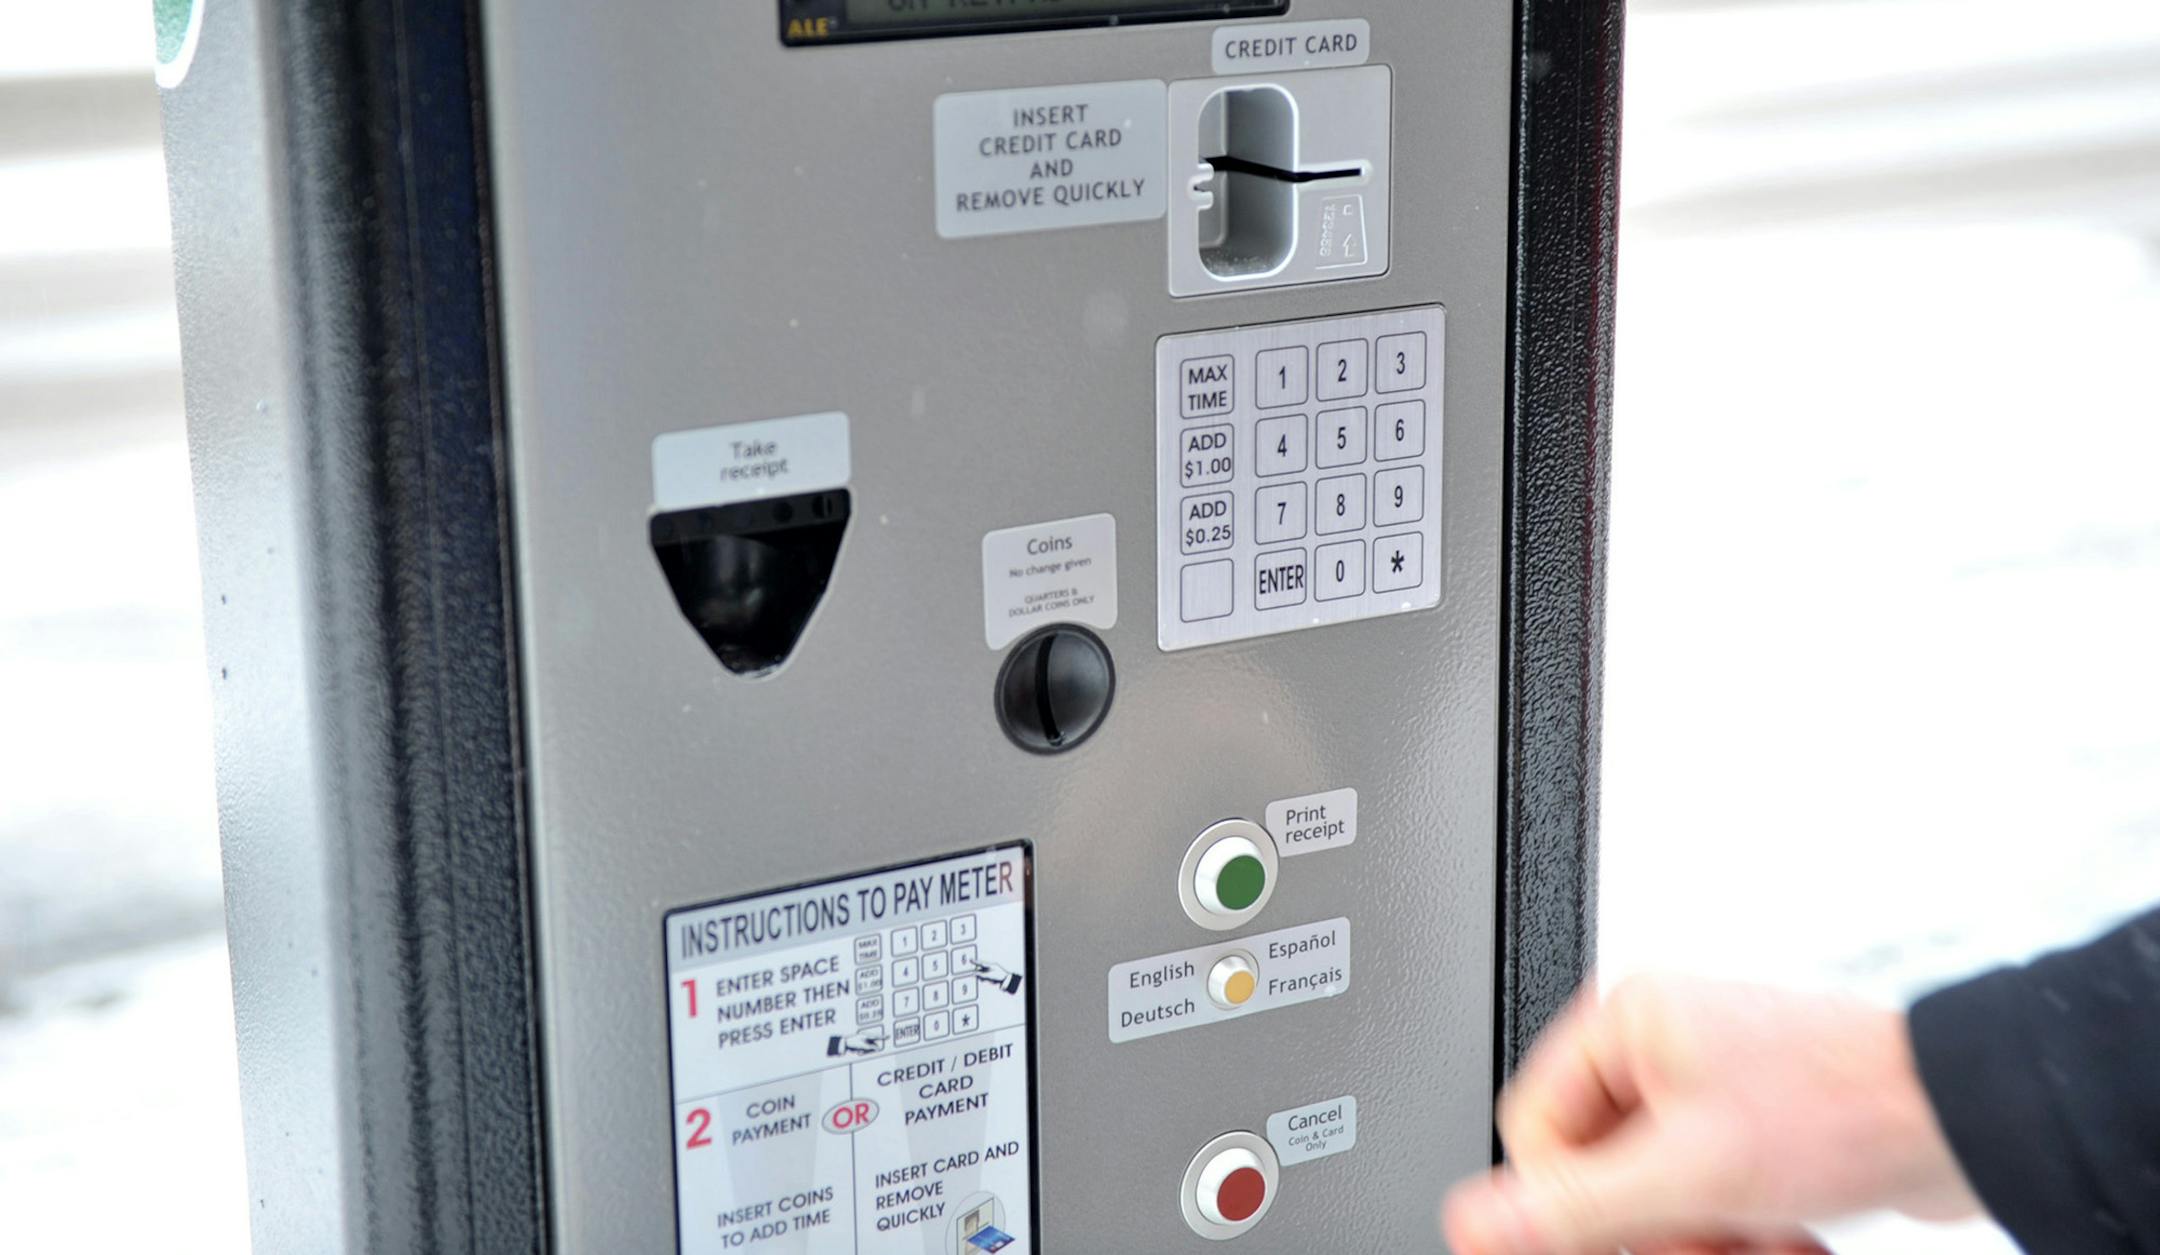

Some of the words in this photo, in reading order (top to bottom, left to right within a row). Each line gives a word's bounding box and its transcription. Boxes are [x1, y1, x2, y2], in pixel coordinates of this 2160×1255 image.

[1225, 36, 1297, 59] CREDIT
[1305, 33, 1357, 54] CARD
[1013, 104, 1089, 127] INSERT
[979, 133, 1057, 157] CREDIT
[1066, 128, 1122, 150] CARD
[1030, 158, 1074, 179] AND
[956, 186, 1044, 212] REMOVE
[1053, 178, 1145, 206] QUICKLY
[1188, 364, 1228, 385] MAX
[1337, 359, 1347, 382] 2
[1396, 352, 1406, 374] 3
[1279, 366, 1286, 389] 1
[1188, 390, 1228, 411] TIME
[1188, 432, 1227, 452] ADD
[1337, 427, 1347, 449] 5
[1395, 419, 1405, 442] 6
[731, 439, 778, 460] Take
[1277, 434, 1288, 457] 4
[720, 459, 788, 481] receipt
[1185, 457, 1232, 478] $1.00
[1336, 493, 1345, 516] 8
[1394, 485, 1403, 508] 9
[1189, 500, 1227, 520] ADD
[1277, 502, 1287, 525] 7
[1026, 536, 1073, 556] Coins
[1185, 525, 1232, 547] $0.25
[1009, 567, 1024, 578] No
[1025, 560, 1062, 575] change
[1064, 557, 1092, 572] given
[1336, 560, 1345, 582] 0
[1259, 564, 1304, 595] ENTER
[1009, 604, 1043, 618] DOLLAR
[1045, 599, 1071, 611] COINS
[1072, 595, 1095, 607] ONLY
[1024, 588, 1070, 604] QUARTERS
[1285, 805, 1326, 826] Print
[1285, 820, 1345, 844] receipt
[681, 892, 850, 960] INSTRUCTIONS
[857, 886, 886, 922] TO
[893, 876, 933, 916] PAY
[940, 860, 1014, 905] METER
[931, 930, 937, 942] 2
[1268, 930, 1336, 960] Español
[716, 967, 774, 997] ENTER
[780, 955, 840, 984] SPACE
[1129, 961, 1195, 989] English
[1268, 966, 1343, 995] Français
[681, 978, 698, 1019] 1
[717, 993, 796, 1024] NUMBER
[802, 979, 850, 1004] THEN
[904, 996, 909, 1008] 7
[1121, 998, 1195, 1028] Deutsch
[718, 1021, 773, 1050] PRESS
[780, 1008, 836, 1036] ENTER
[895, 1023, 920, 1040] ENTER
[877, 1058, 945, 1087] CREDIT
[964, 1043, 1014, 1068] DEBIT
[919, 1074, 974, 1099] CARD
[746, 1095, 796, 1120] COIN
[832, 1102, 870, 1130] OR
[905, 1092, 989, 1125] PAYMENT
[1288, 1104, 1342, 1131] Cancel
[686, 1105, 713, 1150] 2
[732, 1113, 812, 1146] PAYMENT
[1288, 1134, 1310, 1146] Coin
[1312, 1131, 1319, 1140] &
[1322, 1124, 1344, 1138] Card
[1305, 1141, 1327, 1152] Only
[875, 1162, 928, 1189] INSERT
[933, 1150, 980, 1174] CARD
[984, 1140, 1020, 1162] AND
[875, 1180, 944, 1211] REMOVE
[717, 1202, 773, 1229] INSERT
[778, 1186, 834, 1214] COINS
[876, 1202, 946, 1233] QUICKLY
[721, 1232, 743, 1249] TO
[750, 1219, 788, 1243] ADD
[793, 1209, 831, 1232] TIME
